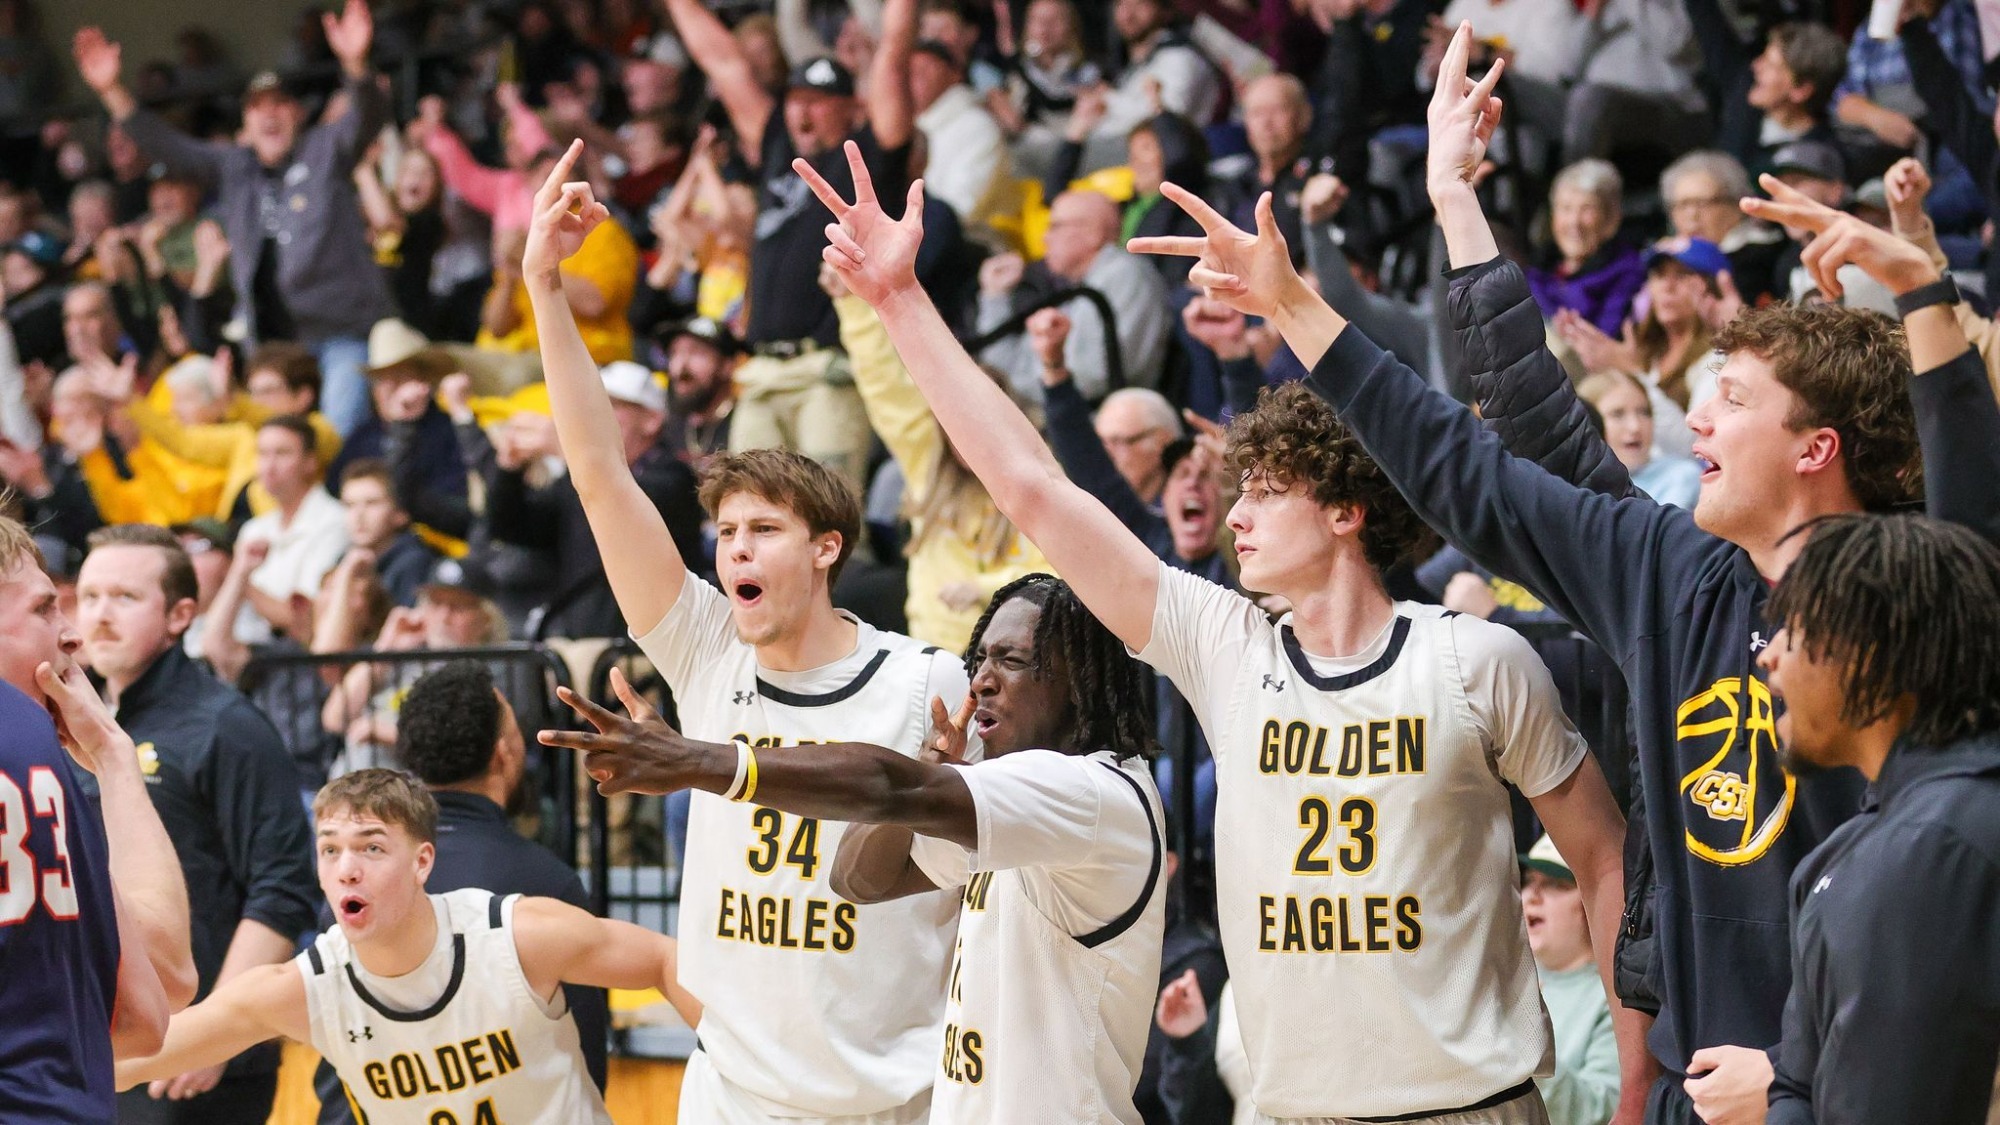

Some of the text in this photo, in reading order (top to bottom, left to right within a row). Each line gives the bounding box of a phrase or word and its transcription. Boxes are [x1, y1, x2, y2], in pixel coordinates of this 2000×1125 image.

[1259, 716, 1427, 778] GOLDEN
[1692, 771, 1749, 820] CSI
[747, 805, 821, 881] 34
[1292, 794, 1379, 876] 23
[717, 888, 858, 953] EAGLES
[1259, 893, 1422, 953] EAGLES
[364, 1028, 523, 1100] GOLDEN
